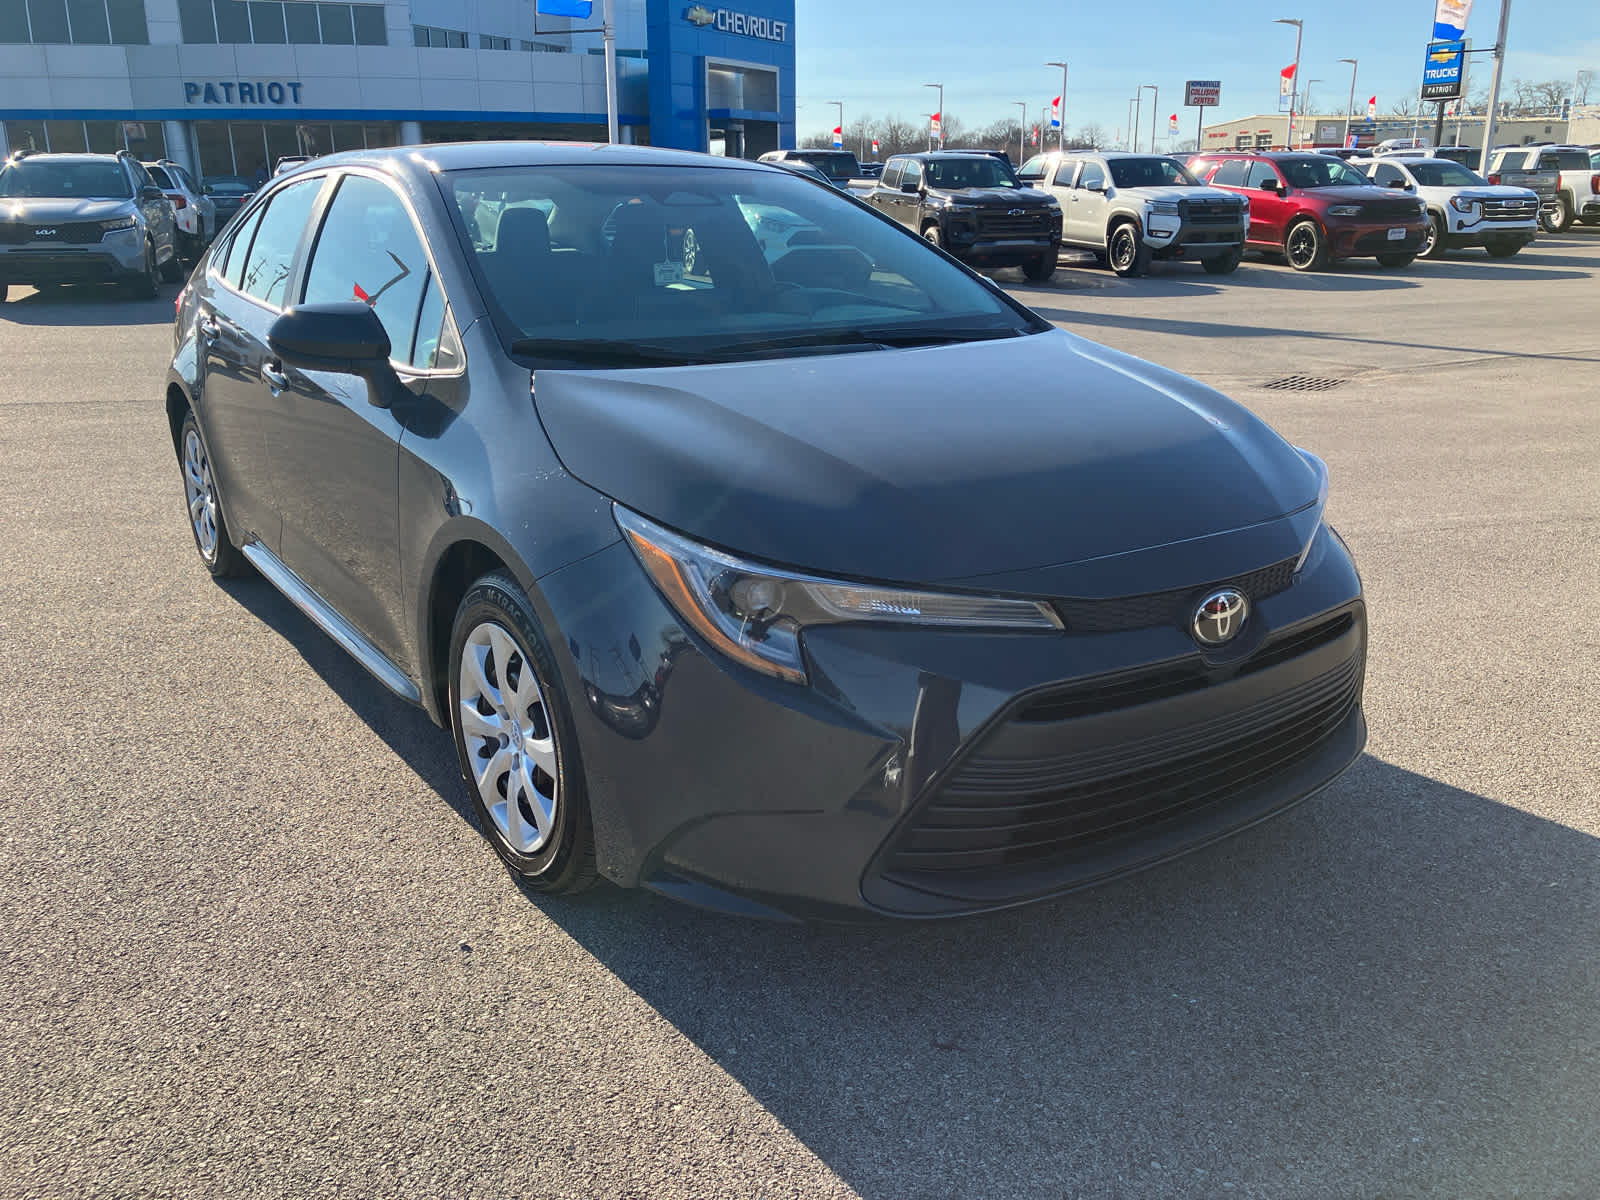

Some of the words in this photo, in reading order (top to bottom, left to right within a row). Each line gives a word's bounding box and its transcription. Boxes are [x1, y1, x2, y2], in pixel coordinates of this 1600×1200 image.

[717, 9, 786, 41] CHEVROLET
[1426, 67, 1458, 79] TRUCKS
[184, 82, 302, 104] PATRIOT
[1427, 85, 1453, 94] PATRIOT
